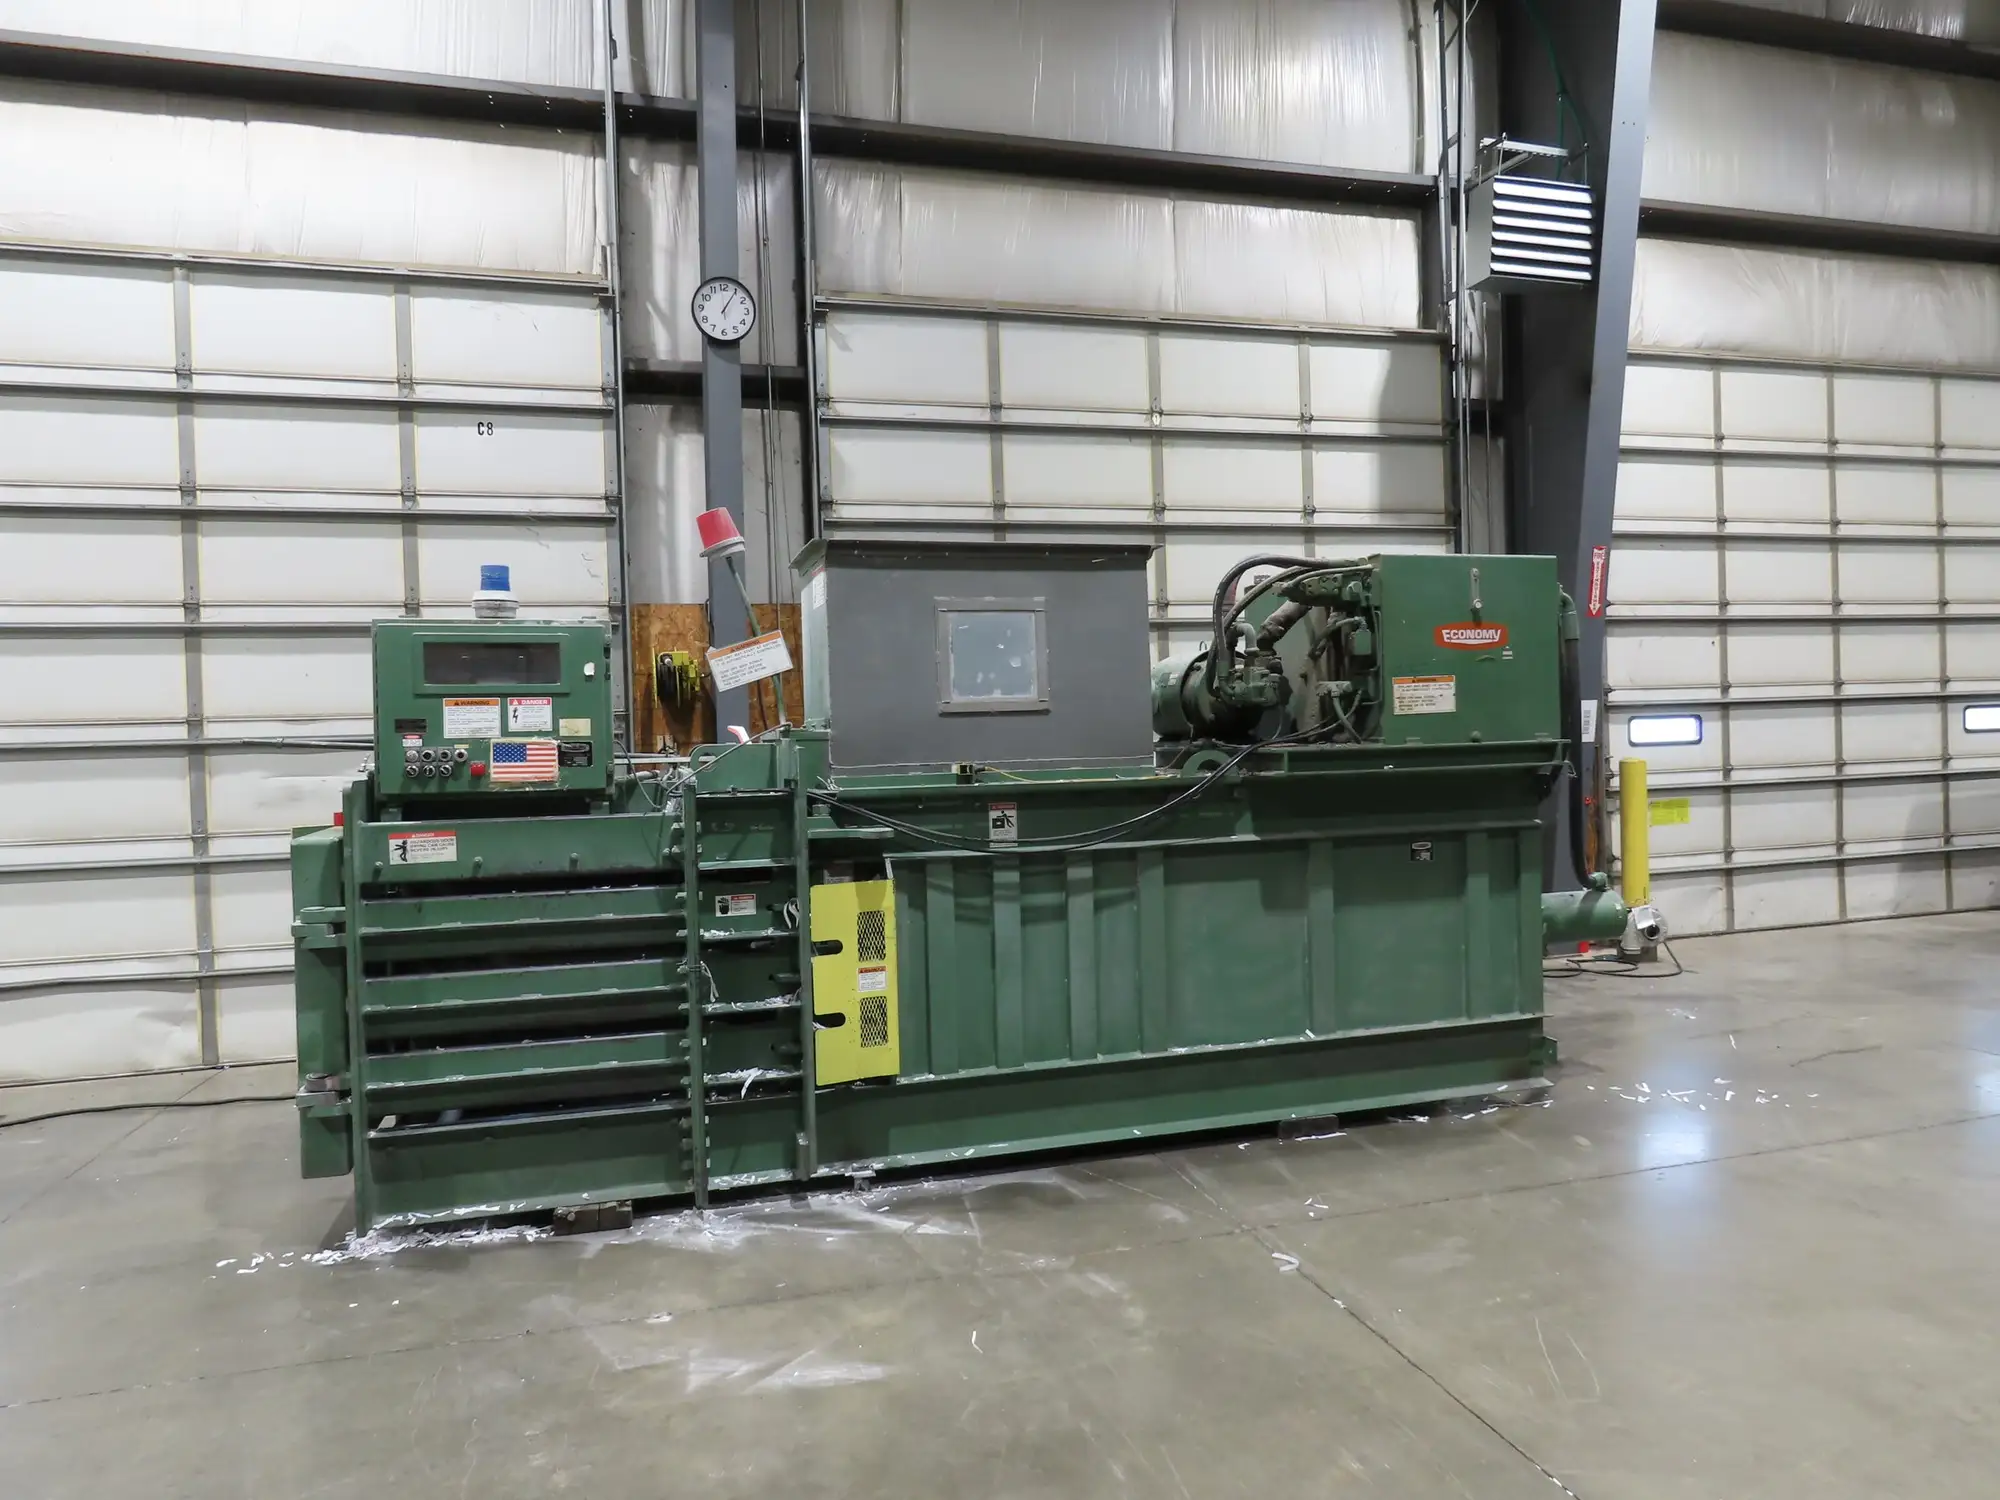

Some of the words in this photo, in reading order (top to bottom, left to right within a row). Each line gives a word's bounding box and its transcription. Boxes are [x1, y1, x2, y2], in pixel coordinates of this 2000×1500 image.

[720, 284, 729, 292] 12
[698, 304, 704, 312] 9
[710, 324, 716, 332] 7
[478, 422, 494, 436] C8
[1442, 629, 1501, 642] ECONOMY
